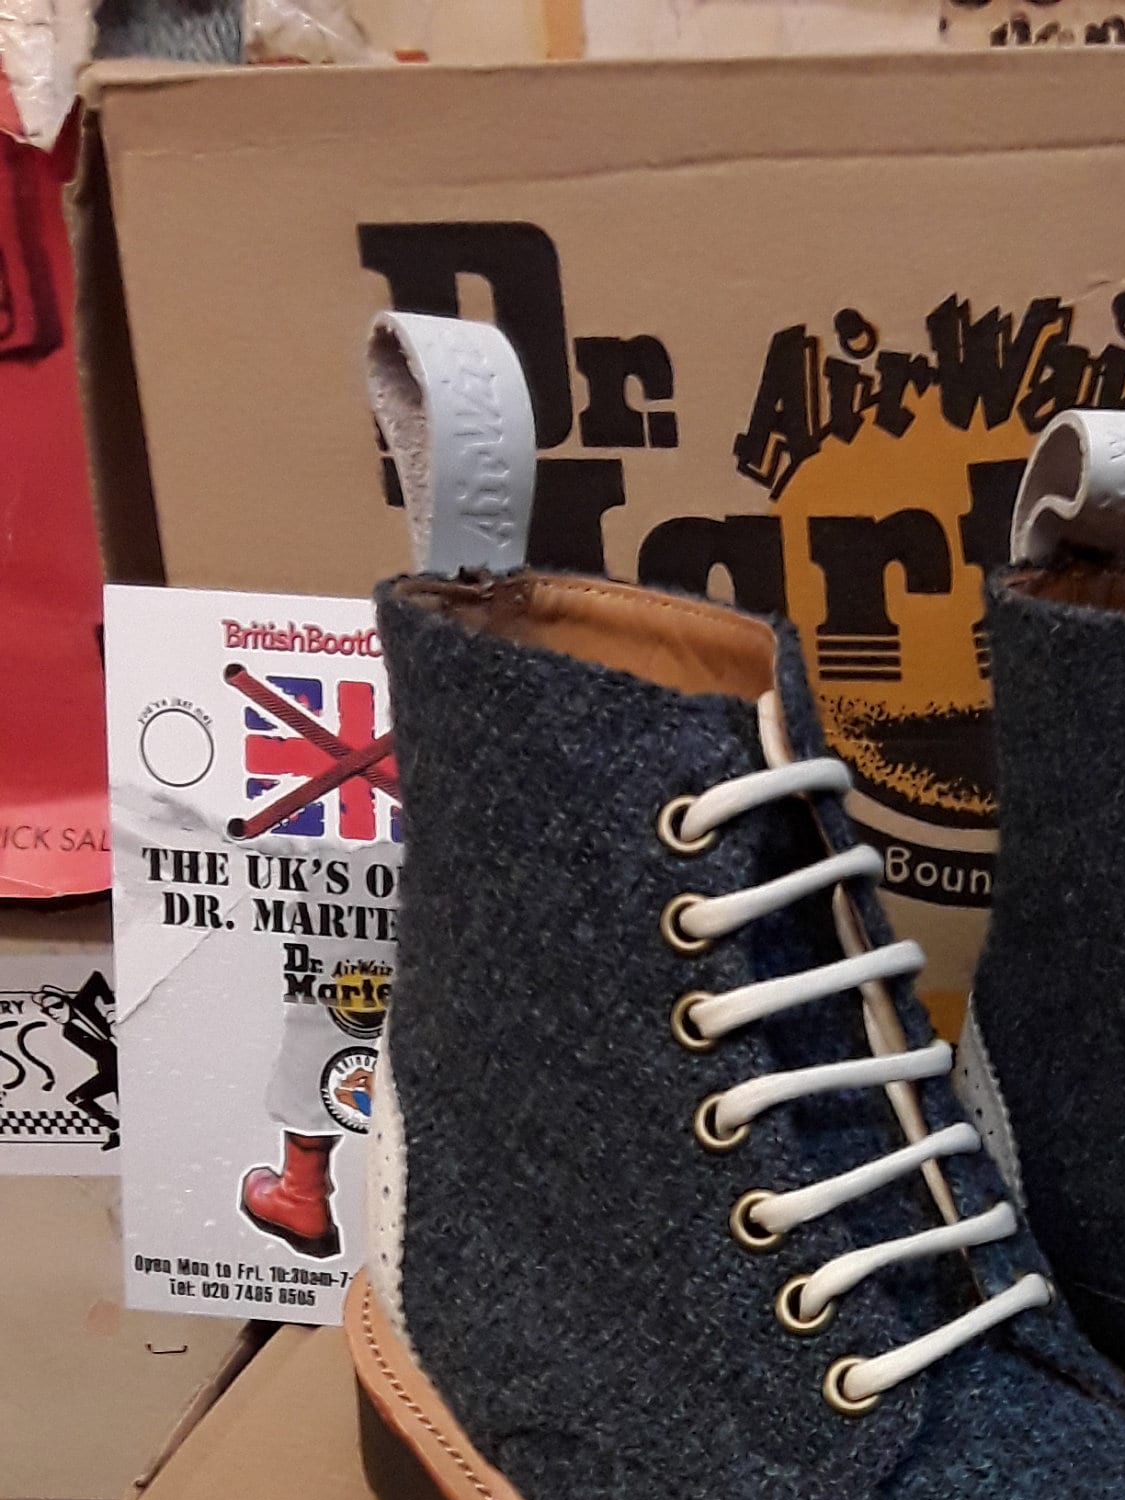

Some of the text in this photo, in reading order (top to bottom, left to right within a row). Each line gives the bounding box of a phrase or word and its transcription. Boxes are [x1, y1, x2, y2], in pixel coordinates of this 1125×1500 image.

[222, 619, 383, 658] BritishBootC
[142, 847, 230, 886] THE
[246, 854, 350, 895] UK'S
[884, 846, 993, 895] Boun
[162, 891, 400, 942] DR. MARTE
[283, 973, 393, 1007] Marte
[134, 1255, 172, 1275] Open
[177, 1258, 210, 1277] Mon
[216, 1262, 232, 1279] to
[202, 1281, 229, 1300] 020
